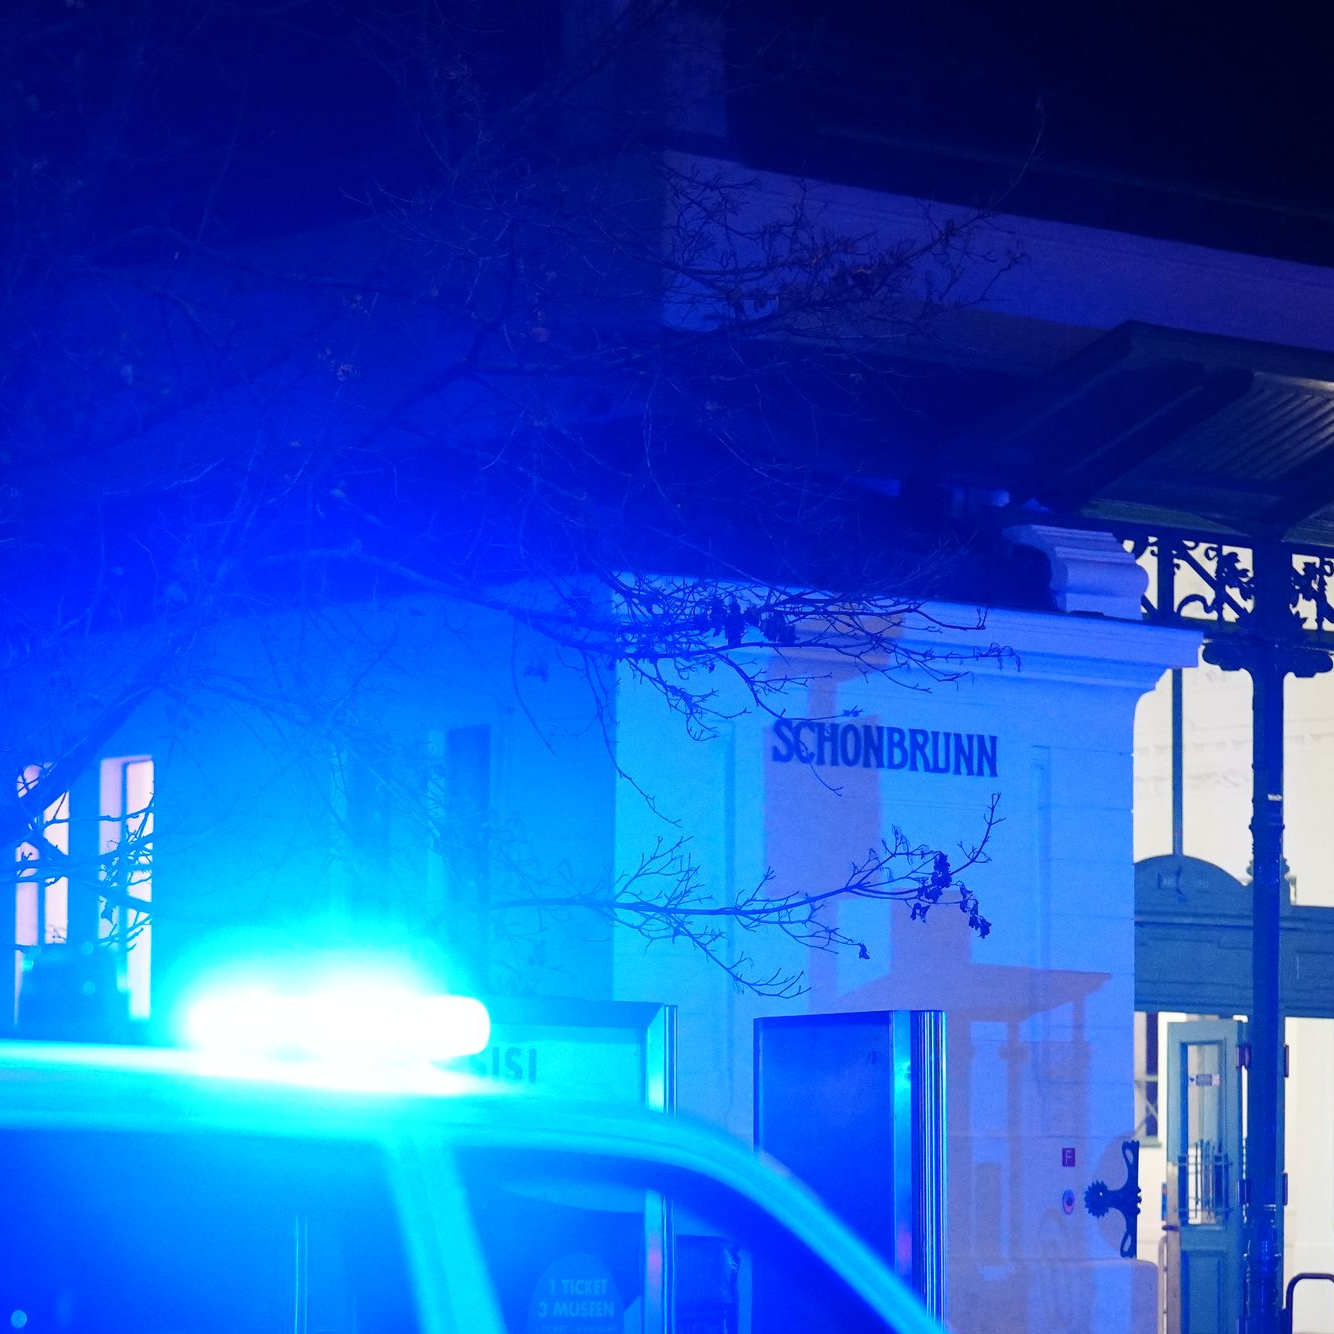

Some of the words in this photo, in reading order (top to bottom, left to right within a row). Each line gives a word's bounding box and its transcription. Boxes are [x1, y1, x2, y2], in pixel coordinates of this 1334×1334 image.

[772, 709, 998, 778] SCHÖNBRUNN
[549, 1279, 556, 1296] 1
[560, 1279, 608, 1296] TICKET
[538, 1301, 548, 1318] 3
[553, 1301, 615, 1318] MUSEEN
